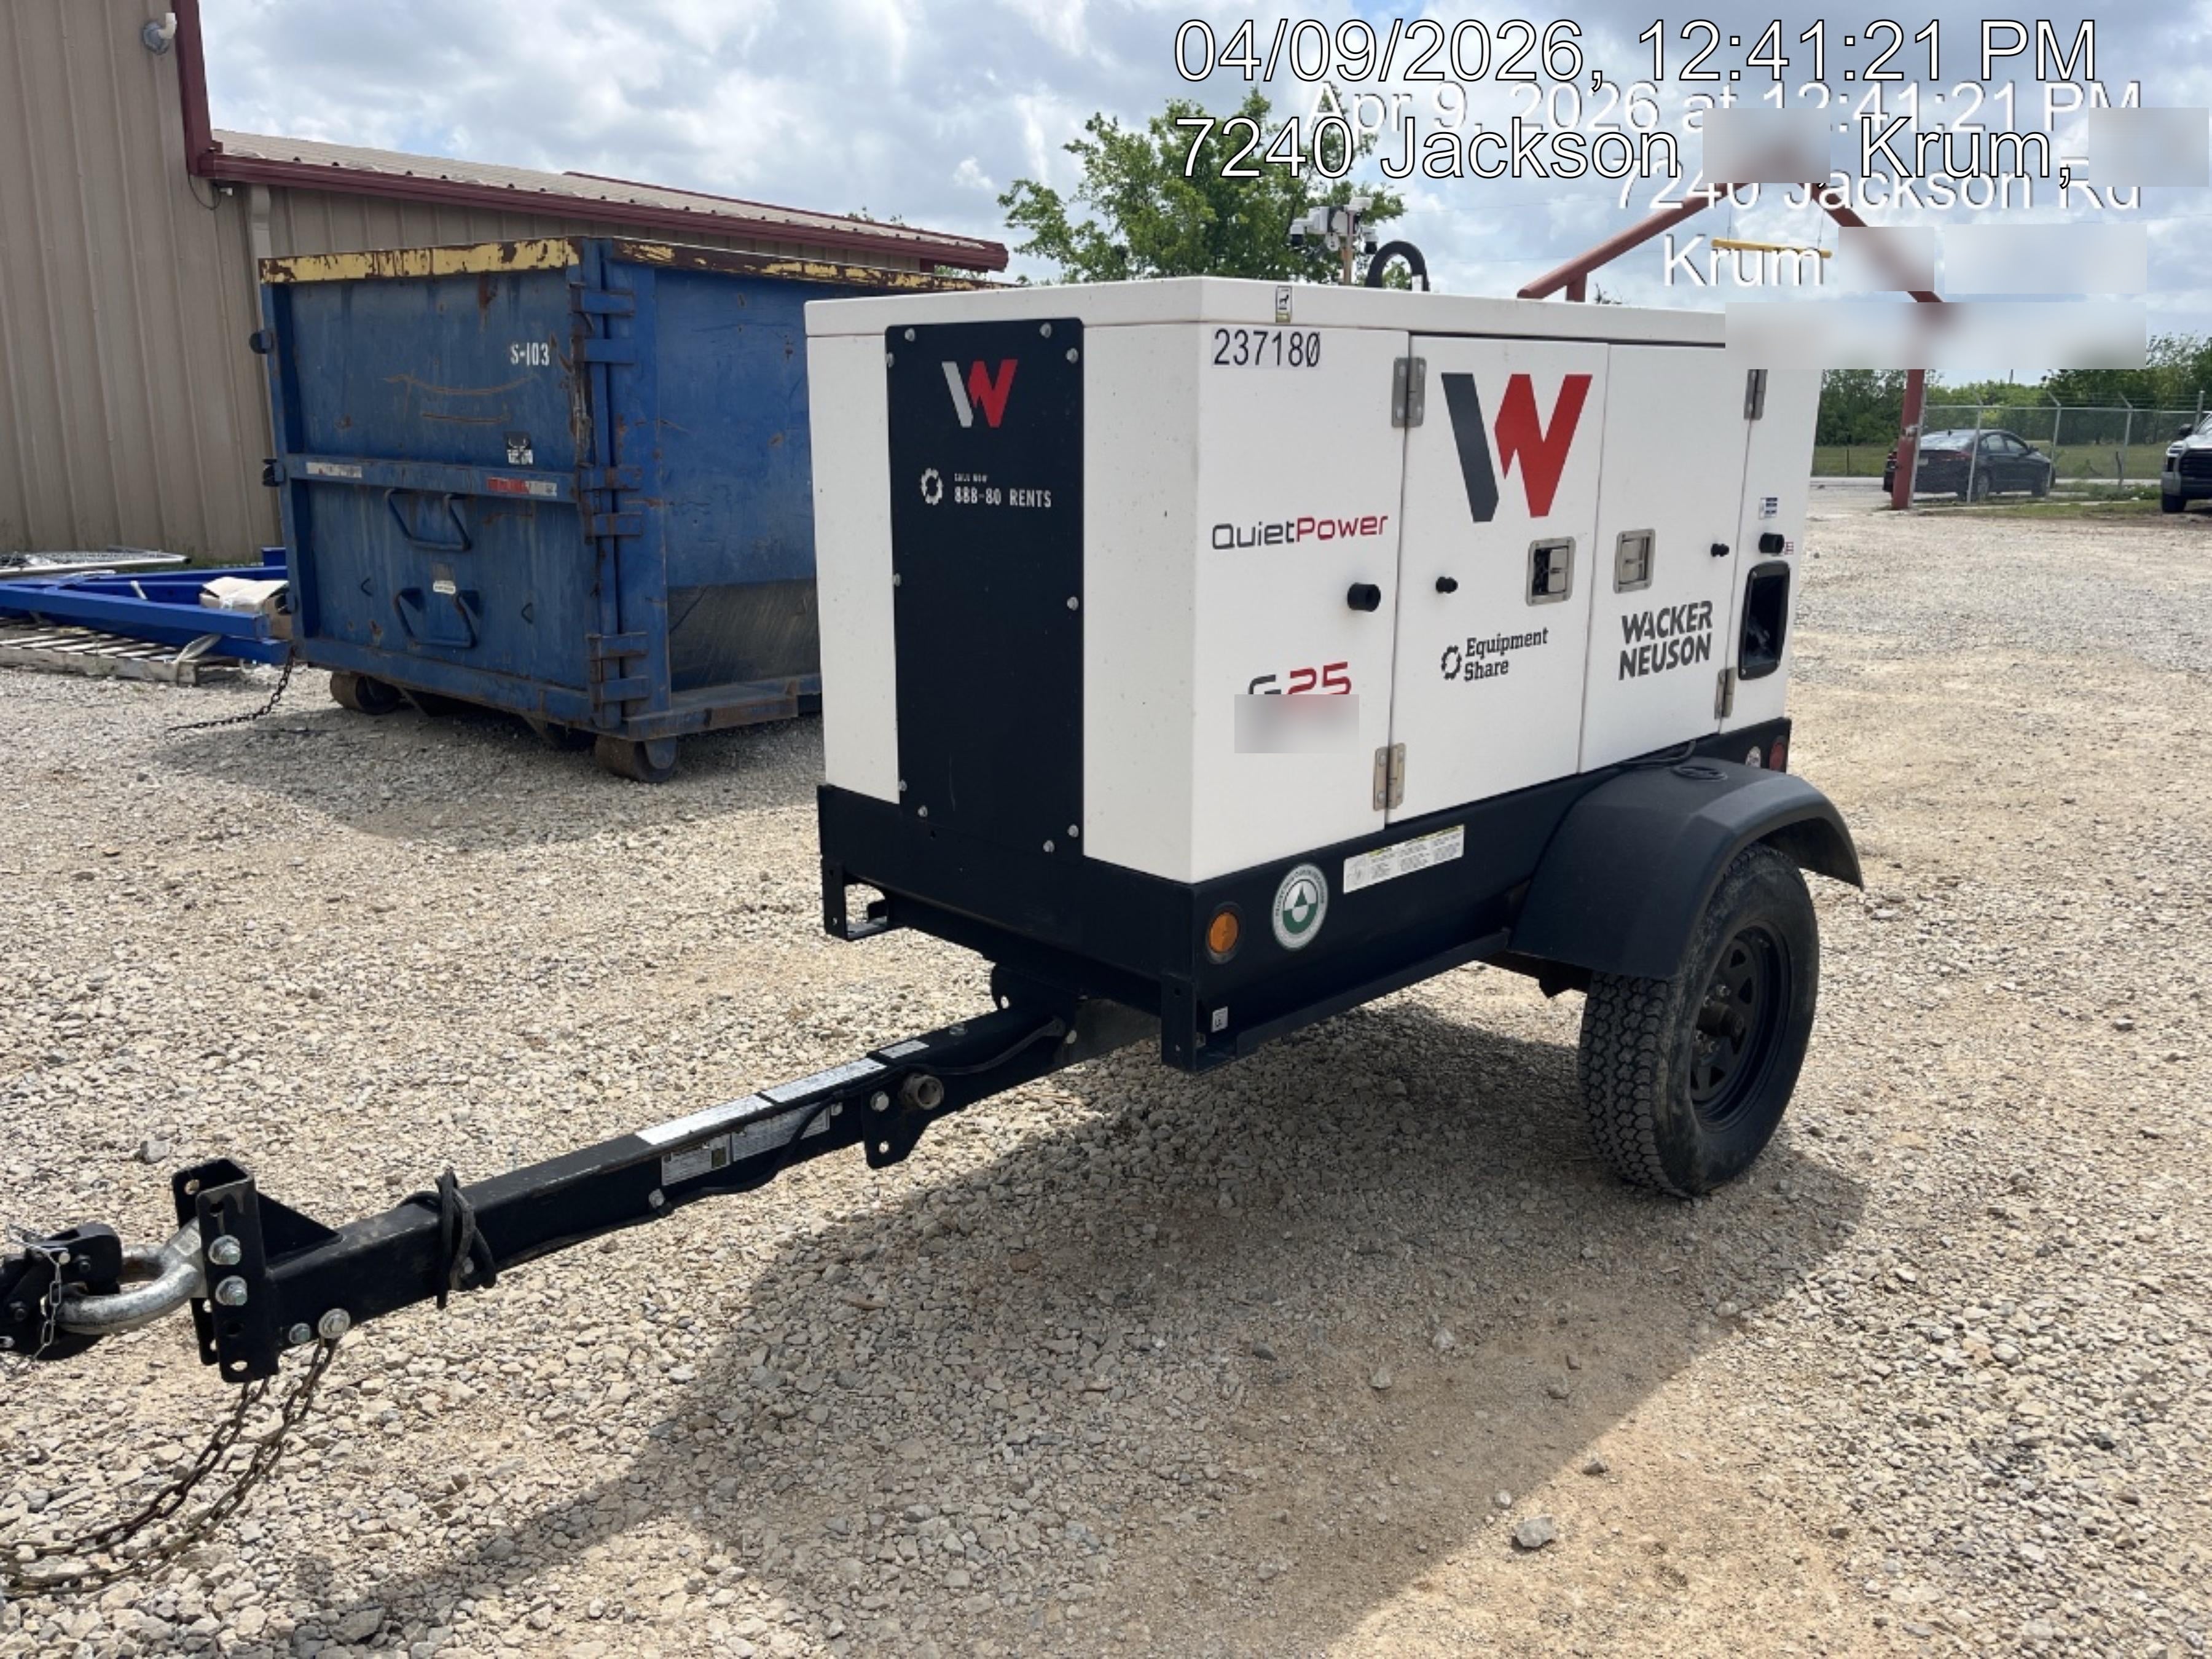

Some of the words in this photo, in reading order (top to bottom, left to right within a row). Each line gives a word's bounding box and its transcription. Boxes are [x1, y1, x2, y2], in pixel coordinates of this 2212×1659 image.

[510, 342, 550, 366] S-103
[1214, 328, 1321, 367] 237180
[954, 486, 1002, 506] 888-80
[1010, 488, 1052, 508] RENTS
[1212, 516, 1389, 550] QuietPower
[1622, 600, 1713, 644] WACKER
[1465, 627, 1549, 660] Equipment
[1618, 632, 1712, 680] NEUSON
[1464, 659, 1509, 681] Share
